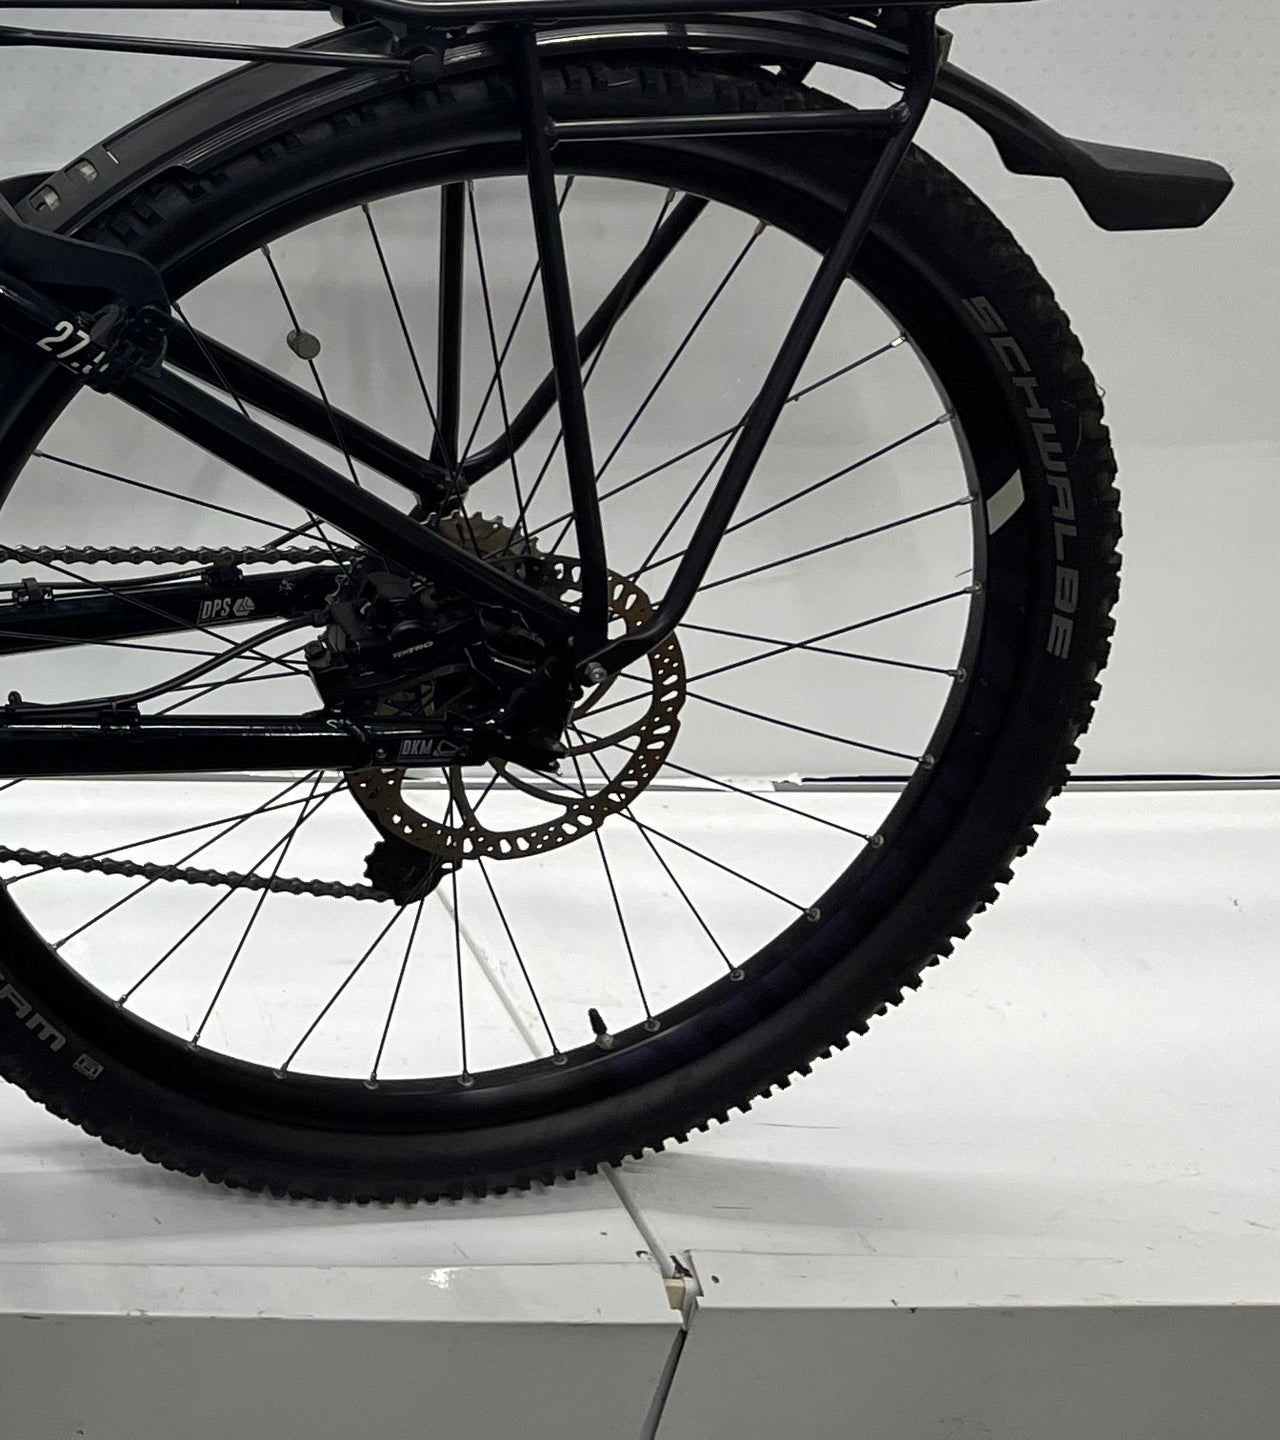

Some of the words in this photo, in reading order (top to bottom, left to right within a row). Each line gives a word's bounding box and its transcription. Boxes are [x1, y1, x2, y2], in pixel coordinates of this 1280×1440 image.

[961, 295, 1081, 660] SCHWALBE
[201, 597, 232, 619] DPS
[401, 738, 434, 756] DKM
